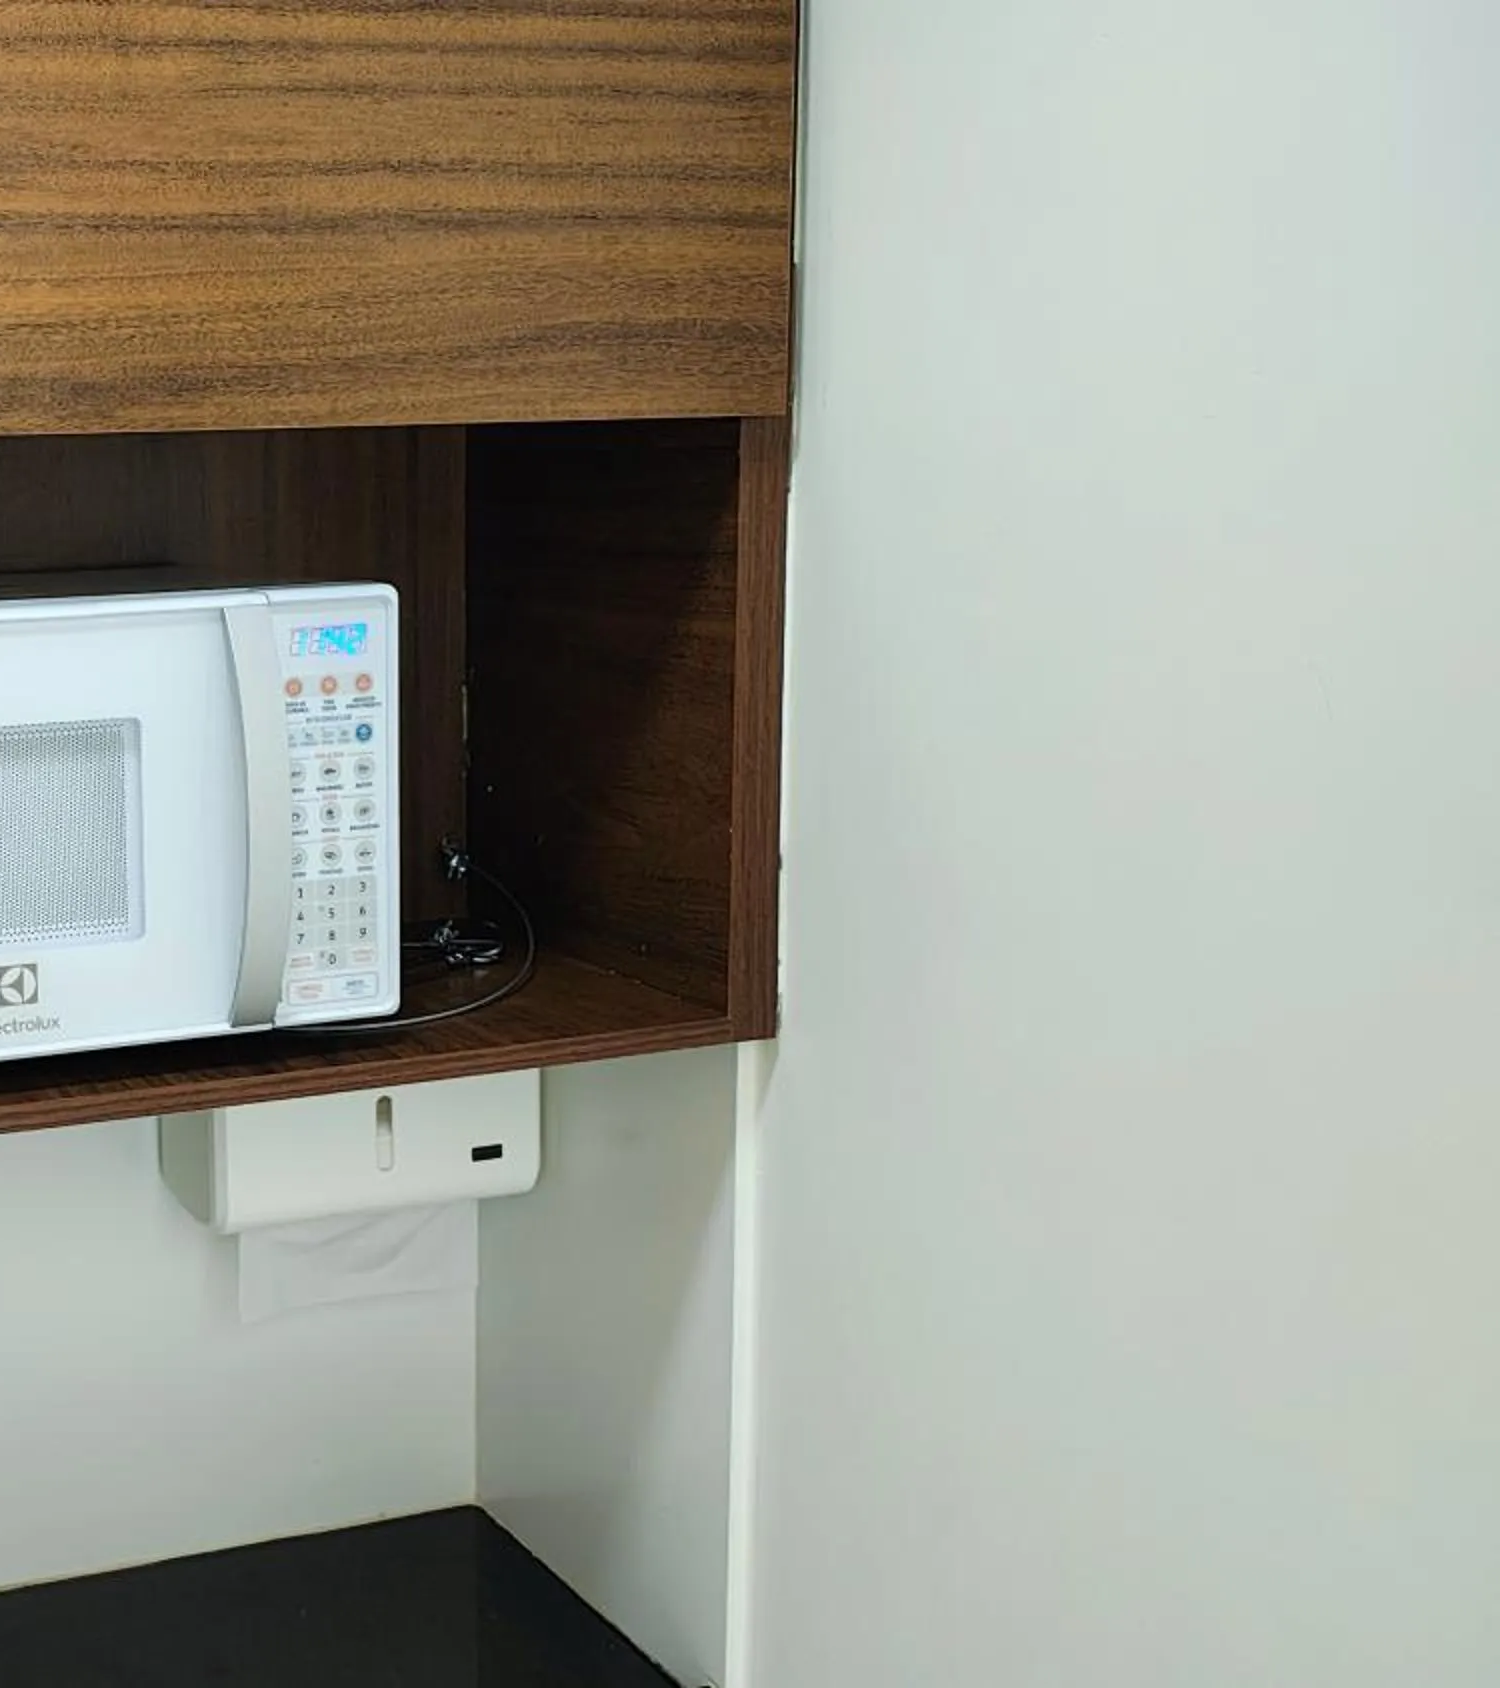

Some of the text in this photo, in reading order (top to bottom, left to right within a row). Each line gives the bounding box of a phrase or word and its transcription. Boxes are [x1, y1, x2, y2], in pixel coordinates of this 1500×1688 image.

[296, 881, 367, 900] 1 2 3
[296, 905, 367, 922] 4 5 6
[296, 927, 367, 945] 7 8 9
[328, 952, 337, 965] 0
